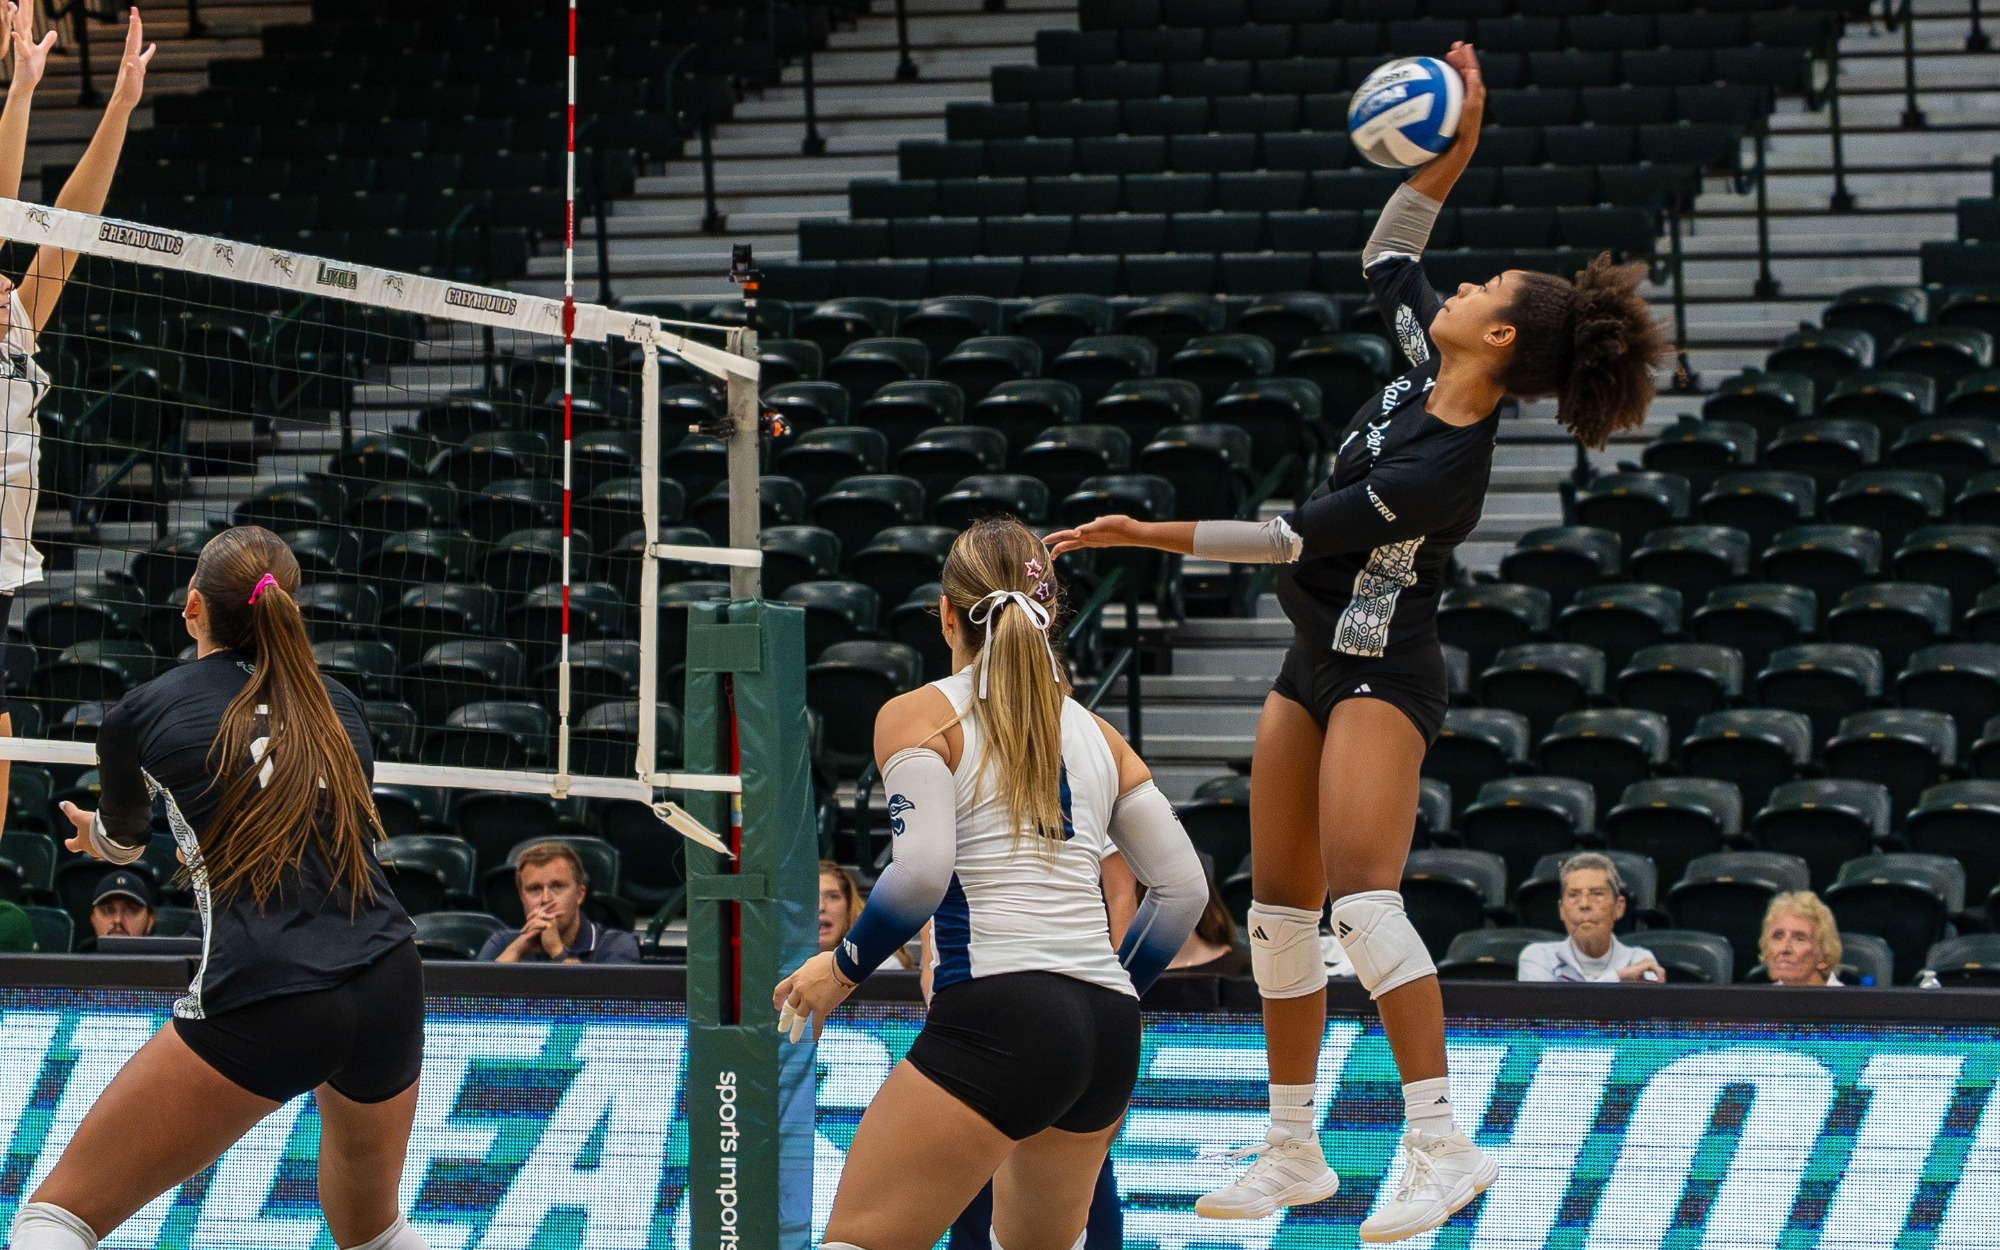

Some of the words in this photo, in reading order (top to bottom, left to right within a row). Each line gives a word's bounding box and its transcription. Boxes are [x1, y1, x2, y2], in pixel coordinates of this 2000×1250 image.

[99, 222, 183, 255] GREYHOUNDS
[445, 287, 517, 315] GREYHOUNDS
[715, 1071, 740, 1153] sports
[715, 1157, 740, 1250] imports
